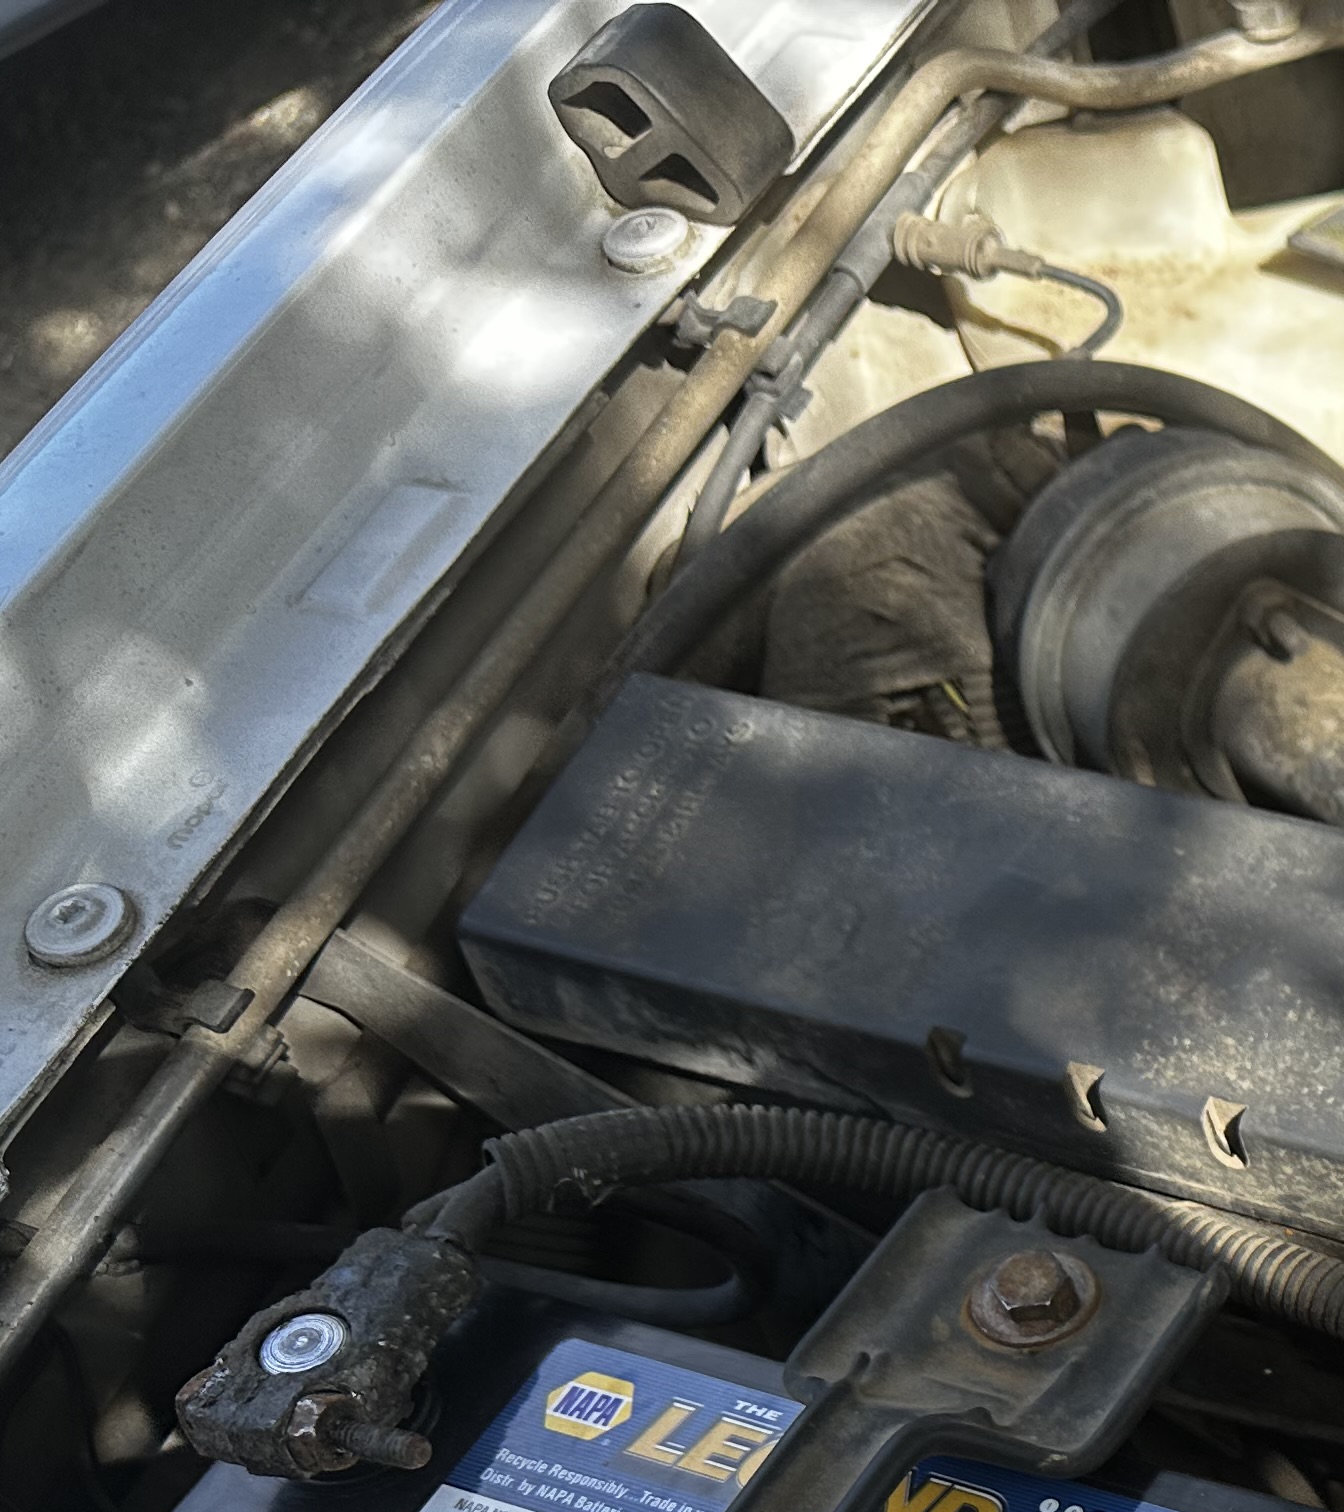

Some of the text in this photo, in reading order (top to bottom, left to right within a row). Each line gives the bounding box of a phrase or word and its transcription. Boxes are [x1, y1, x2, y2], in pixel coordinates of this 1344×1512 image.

[552, 1385, 624, 1427] NAPA
[734, 1399, 785, 1422] THE
[495, 1447, 549, 1473] Recycle
[480, 1467, 515, 1489] Distr.
[517, 1478, 534, 1497] by
[535, 1484, 576, 1507] NAPA
